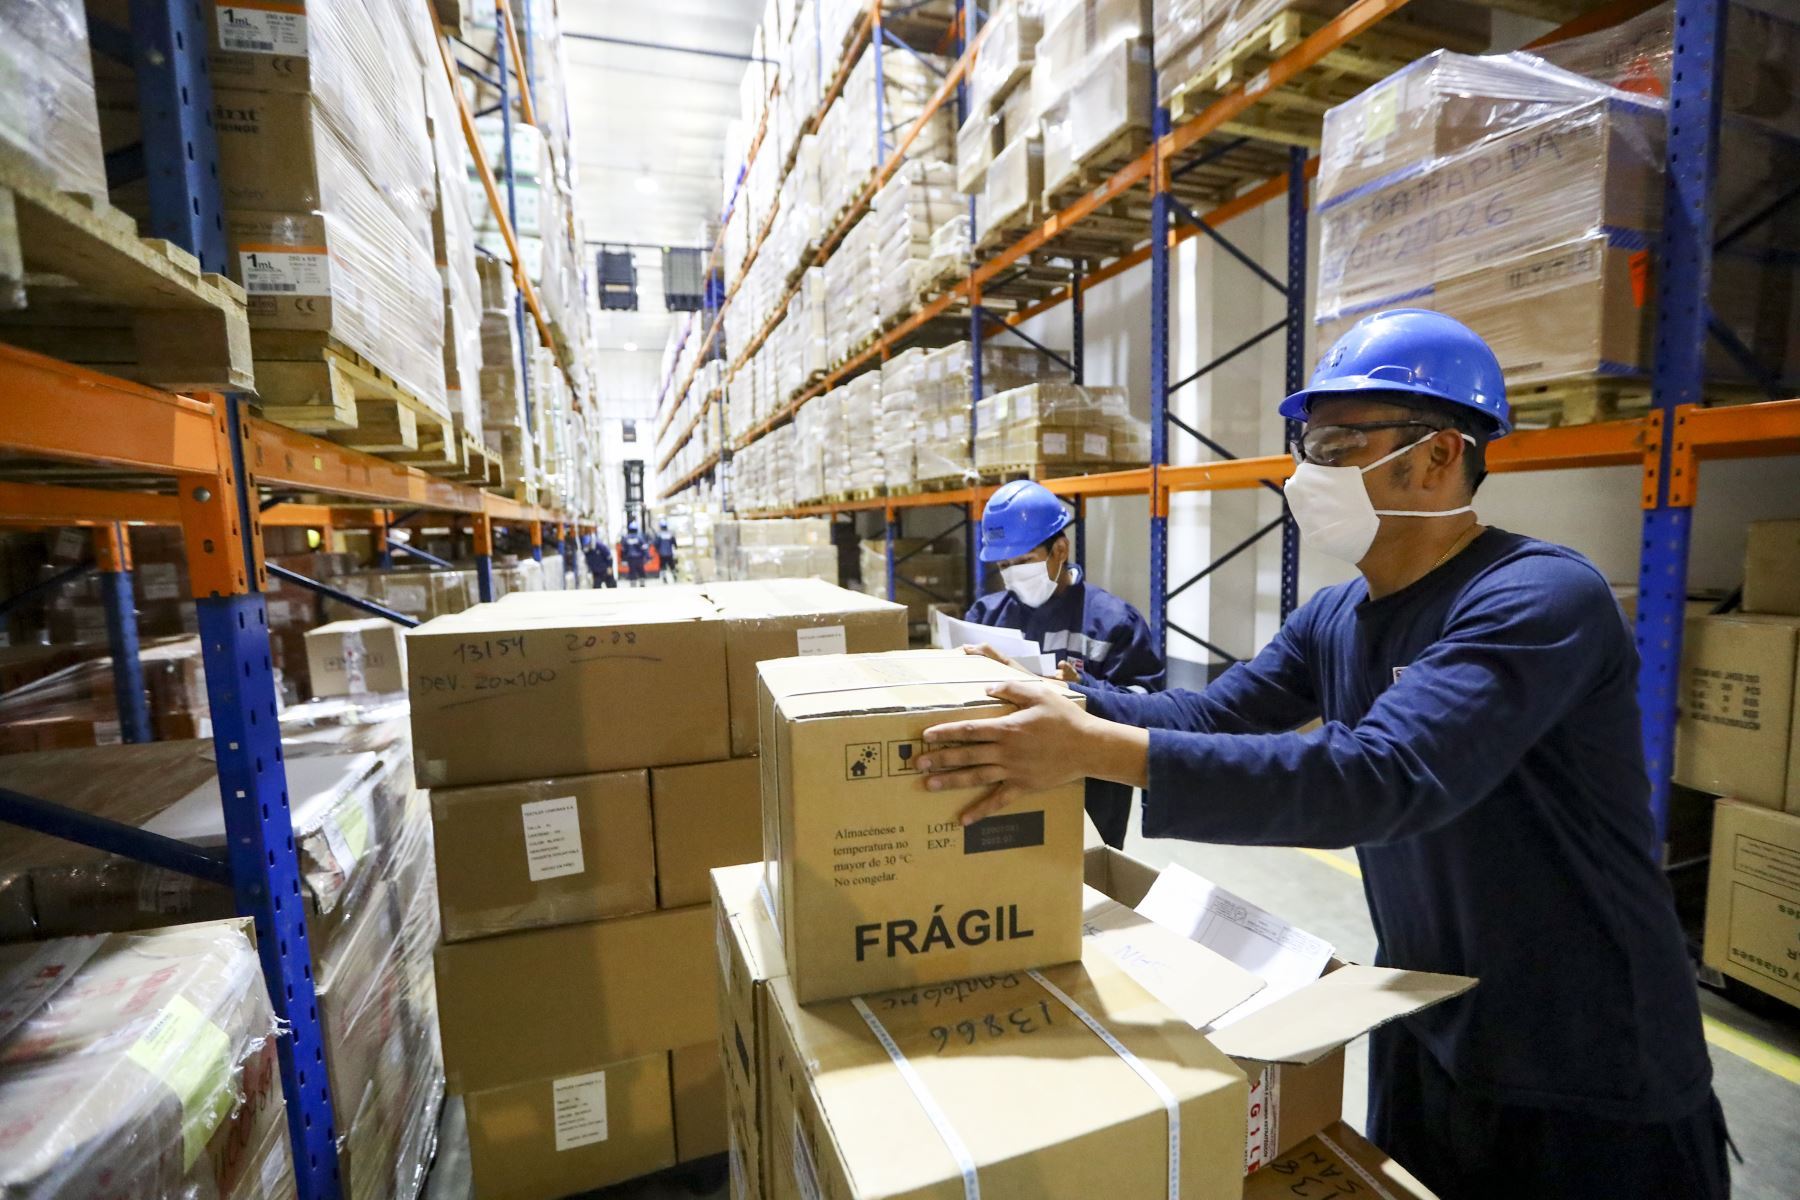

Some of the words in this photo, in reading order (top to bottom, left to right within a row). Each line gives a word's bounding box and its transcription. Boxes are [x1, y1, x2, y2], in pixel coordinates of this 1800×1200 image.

[834, 825, 897, 840] Almacénese
[897, 825, 905, 834] a
[833, 841, 894, 857] temperatura
[895, 839, 909, 850] no
[833, 860, 866, 874] mayor
[868, 857, 881, 869] de
[883, 856, 897, 867] 30
[834, 877, 851, 888] No
[855, 904, 1034, 962] FRÁGIL
[1731, 946, 1789, 979] Glasses
[930, 1001, 1053, 1052] 13866
